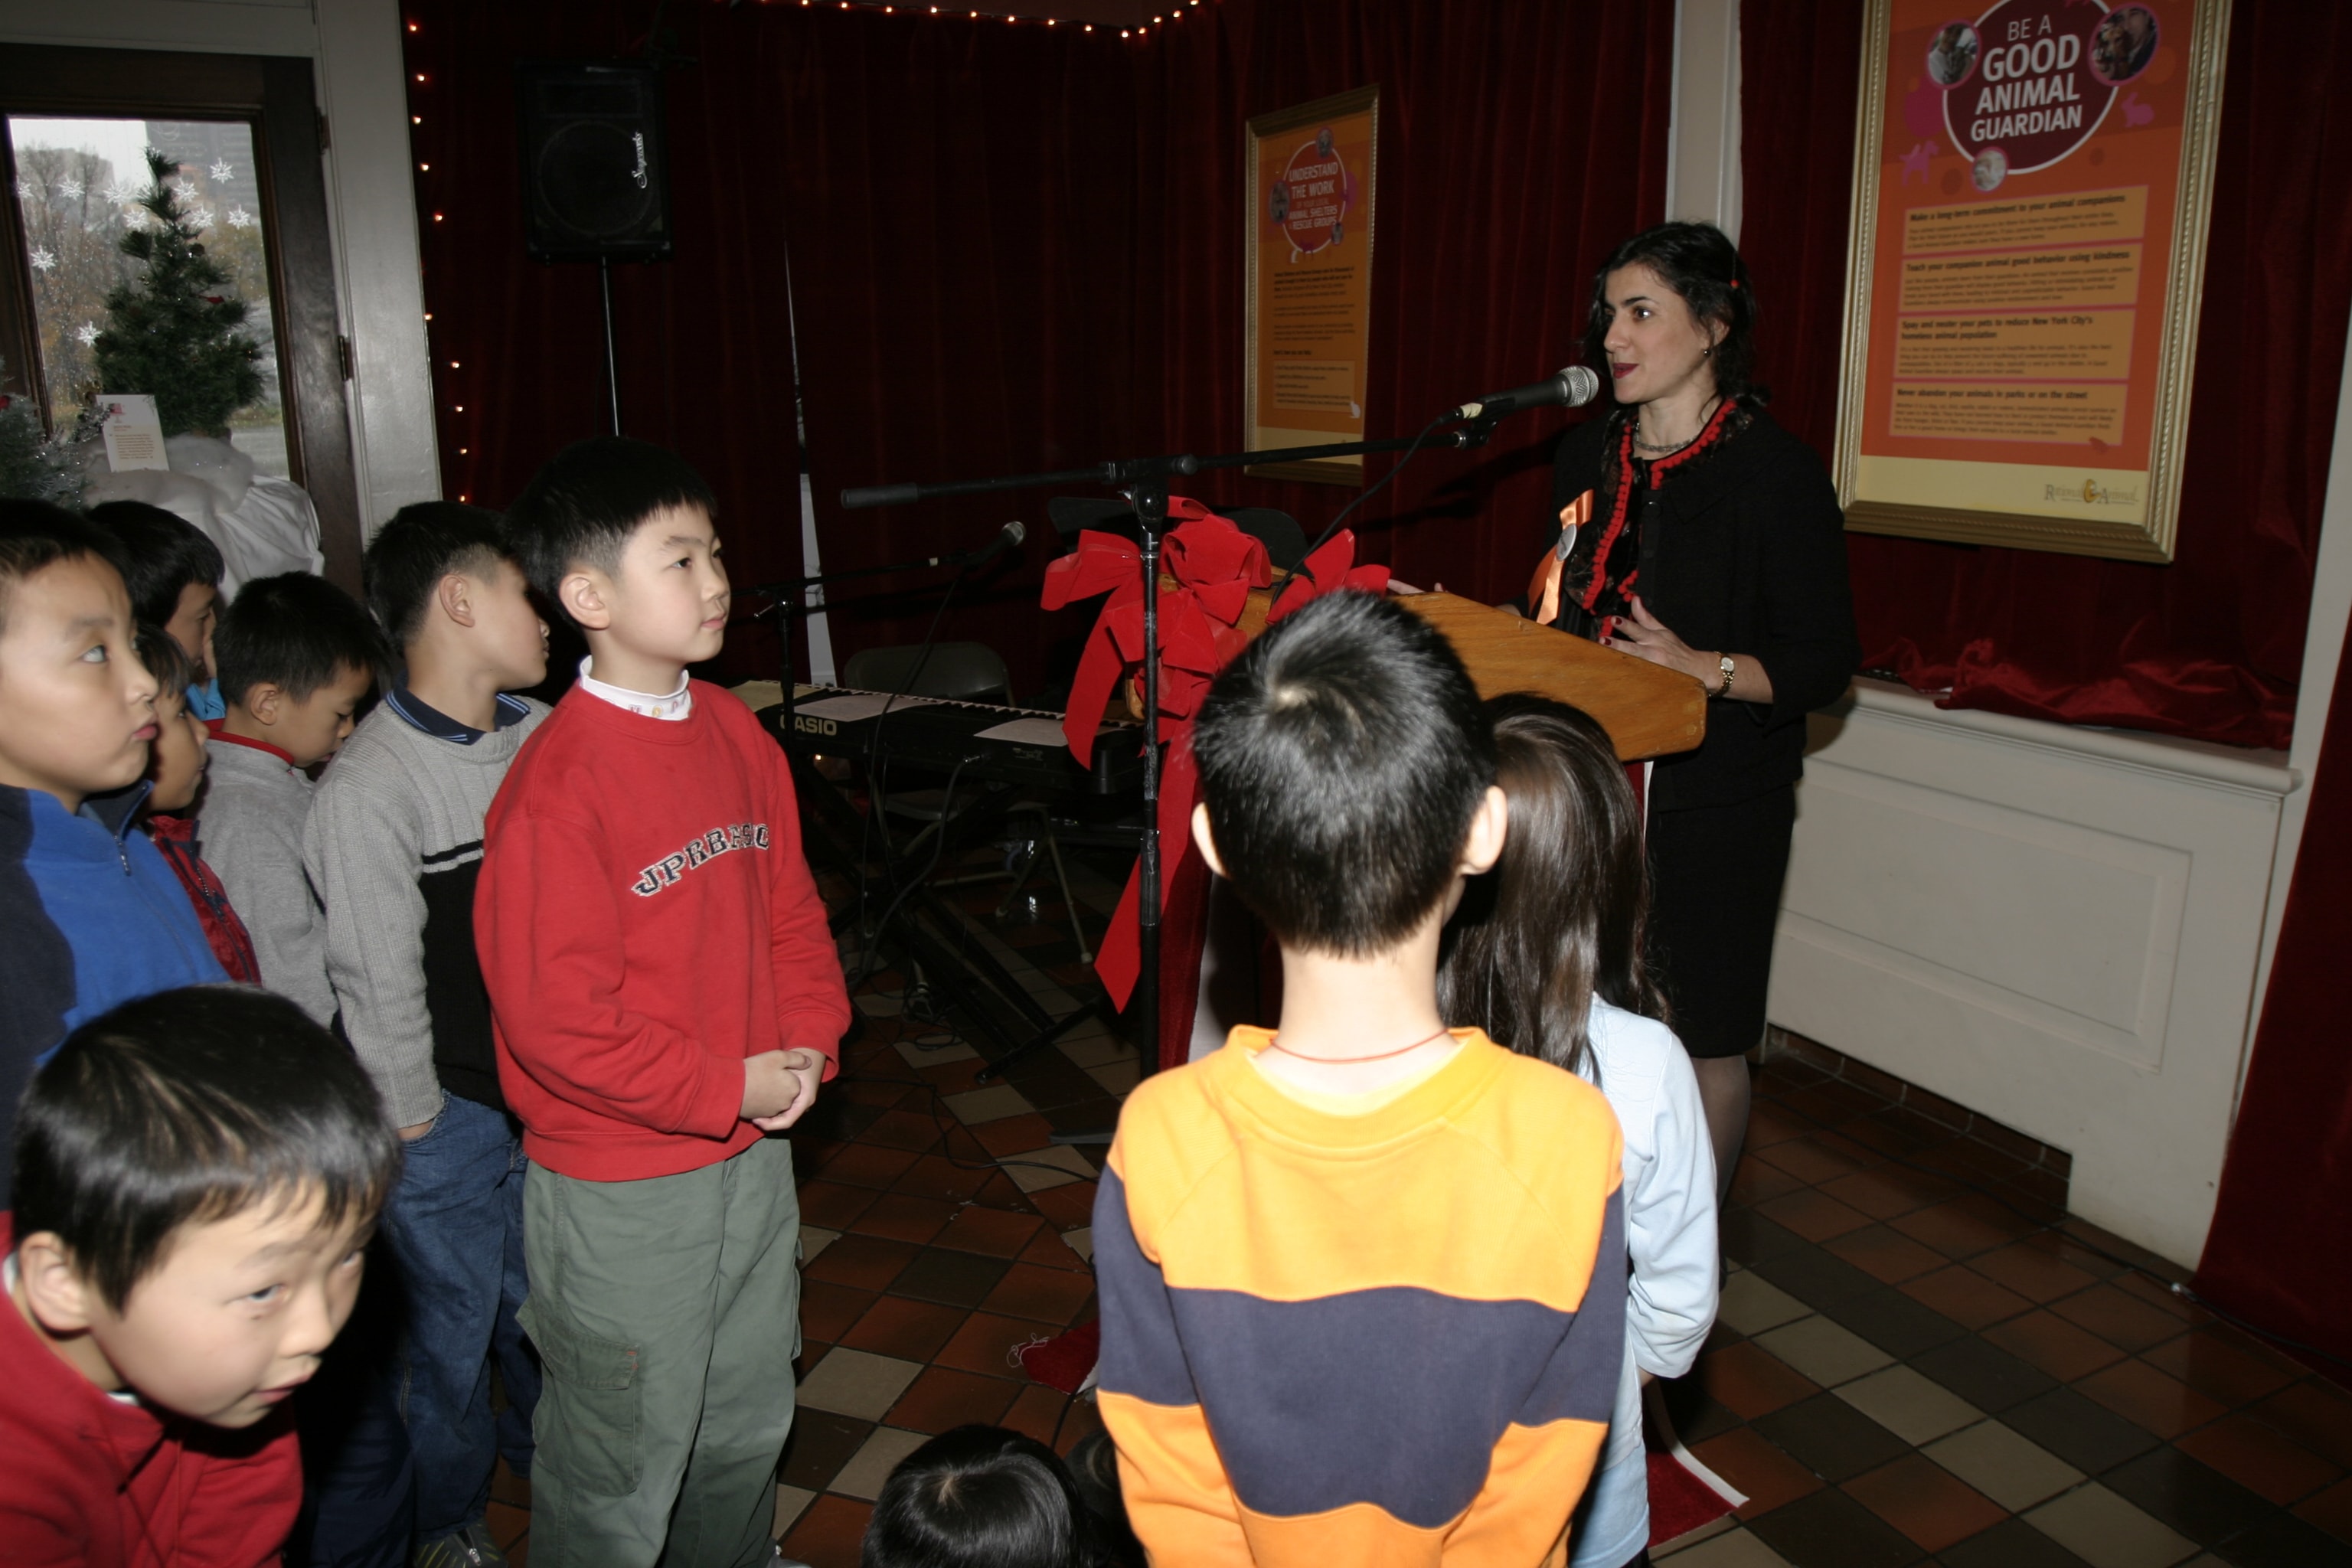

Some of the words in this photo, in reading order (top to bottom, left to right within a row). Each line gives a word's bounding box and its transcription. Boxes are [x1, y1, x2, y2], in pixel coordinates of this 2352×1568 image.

[2007, 18, 2030, 41] BE
[2038, 15, 2052, 34] A
[1983, 34, 2081, 82] GOOD
[1975, 72, 2081, 116] ANIMAL
[1971, 105, 2082, 142] GUARDIAN
[1289, 162, 1338, 182] UNDERSTAND
[1291, 185, 1307, 199] THE
[1308, 179, 1334, 196] WORK
[1288, 210, 1308, 220] ANIMAL
[1310, 204, 1338, 217] SHELTERS
[1909, 212, 1928, 221] Make
[1972, 204, 2017, 216] commitment
[2018, 203, 2027, 211] to
[2027, 202, 2046, 212] your
[2048, 198, 2075, 209] animal
[2076, 193, 2126, 207] companions
[1292, 219, 1312, 230] RESCUE
[1314, 216, 1337, 227] GROUPS
[1906, 263, 1926, 272] Teach
[1928, 263, 1943, 272] your
[1945, 260, 1982, 270] companion
[1984, 257, 2010, 266] animal
[2011, 256, 2030, 266] good
[2033, 253, 2066, 263] behavior
[2068, 252, 2091, 263] using
[2092, 249, 2130, 260] kindness
[1902, 320, 1919, 329] Spay
[1936, 319, 1957, 328] neuter
[1959, 320, 1975, 328] your
[1977, 318, 1993, 328] pets
[2004, 317, 2030, 325] reduce
[2031, 316, 2048, 325] New
[2051, 315, 2068, 325] York
[2070, 315, 2093, 325] City's
[1934, 331, 1958, 339] animal
[1959, 330, 1998, 340] population
[1917, 388, 1947, 397] abandon
[1949, 390, 1964, 398] your
[1966, 388, 1994, 397] animals
[1995, 388, 2003, 397] in
[2004, 389, 2025, 400] parks
[2050, 390, 2063, 398] the
[2064, 390, 2088, 400] street
